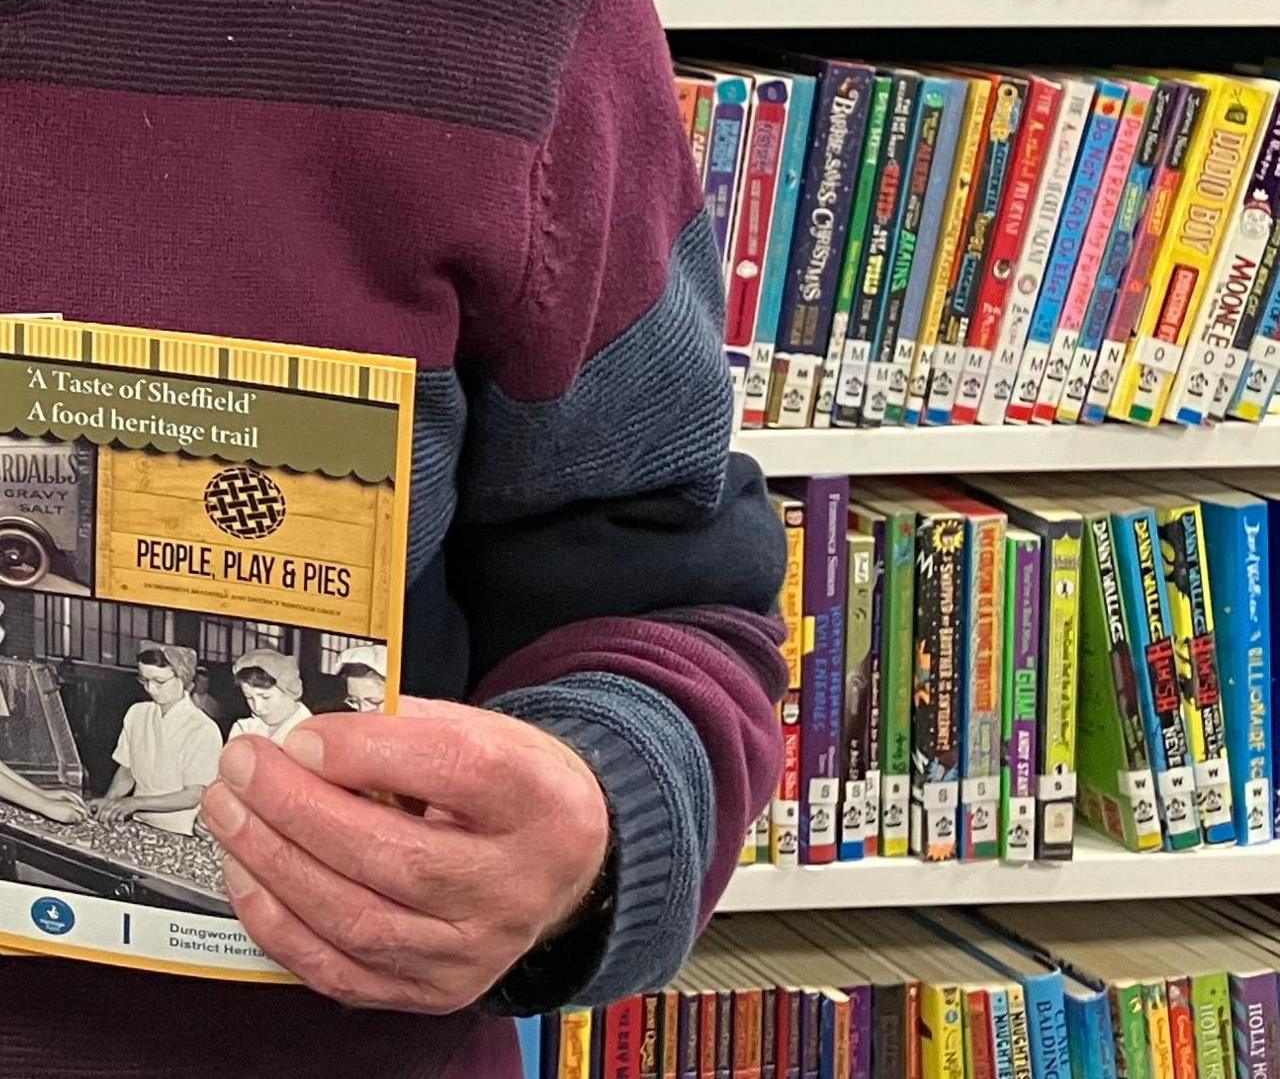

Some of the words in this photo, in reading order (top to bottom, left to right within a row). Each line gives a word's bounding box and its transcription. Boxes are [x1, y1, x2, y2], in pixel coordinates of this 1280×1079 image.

[1196, 129, 1245, 202] RADIO
[1182, 204, 1228, 257] BOY
[52, 371, 113, 397] Taste
[119, 380, 145, 400] of
[27, 401, 45, 421] A
[52, 402, 104, 428] food
[111, 409, 205, 444] heritage
[211, 426, 258, 448] trail
[3, 487, 70, 503] GRAVY
[18, 502, 66, 517] SALT
[1134, 520, 1153, 571] DANNY
[224, 547, 276, 586] PLAY
[281, 559, 296, 589] &
[302, 563, 352, 599] PIES
[1141, 575, 1163, 642] WALLACE
[1247, 647, 1265, 752] BILLIONAIRE
[169, 937, 220, 953] District
[224, 944, 264, 956] Herita
[170, 923, 246, 942] Dungworth
